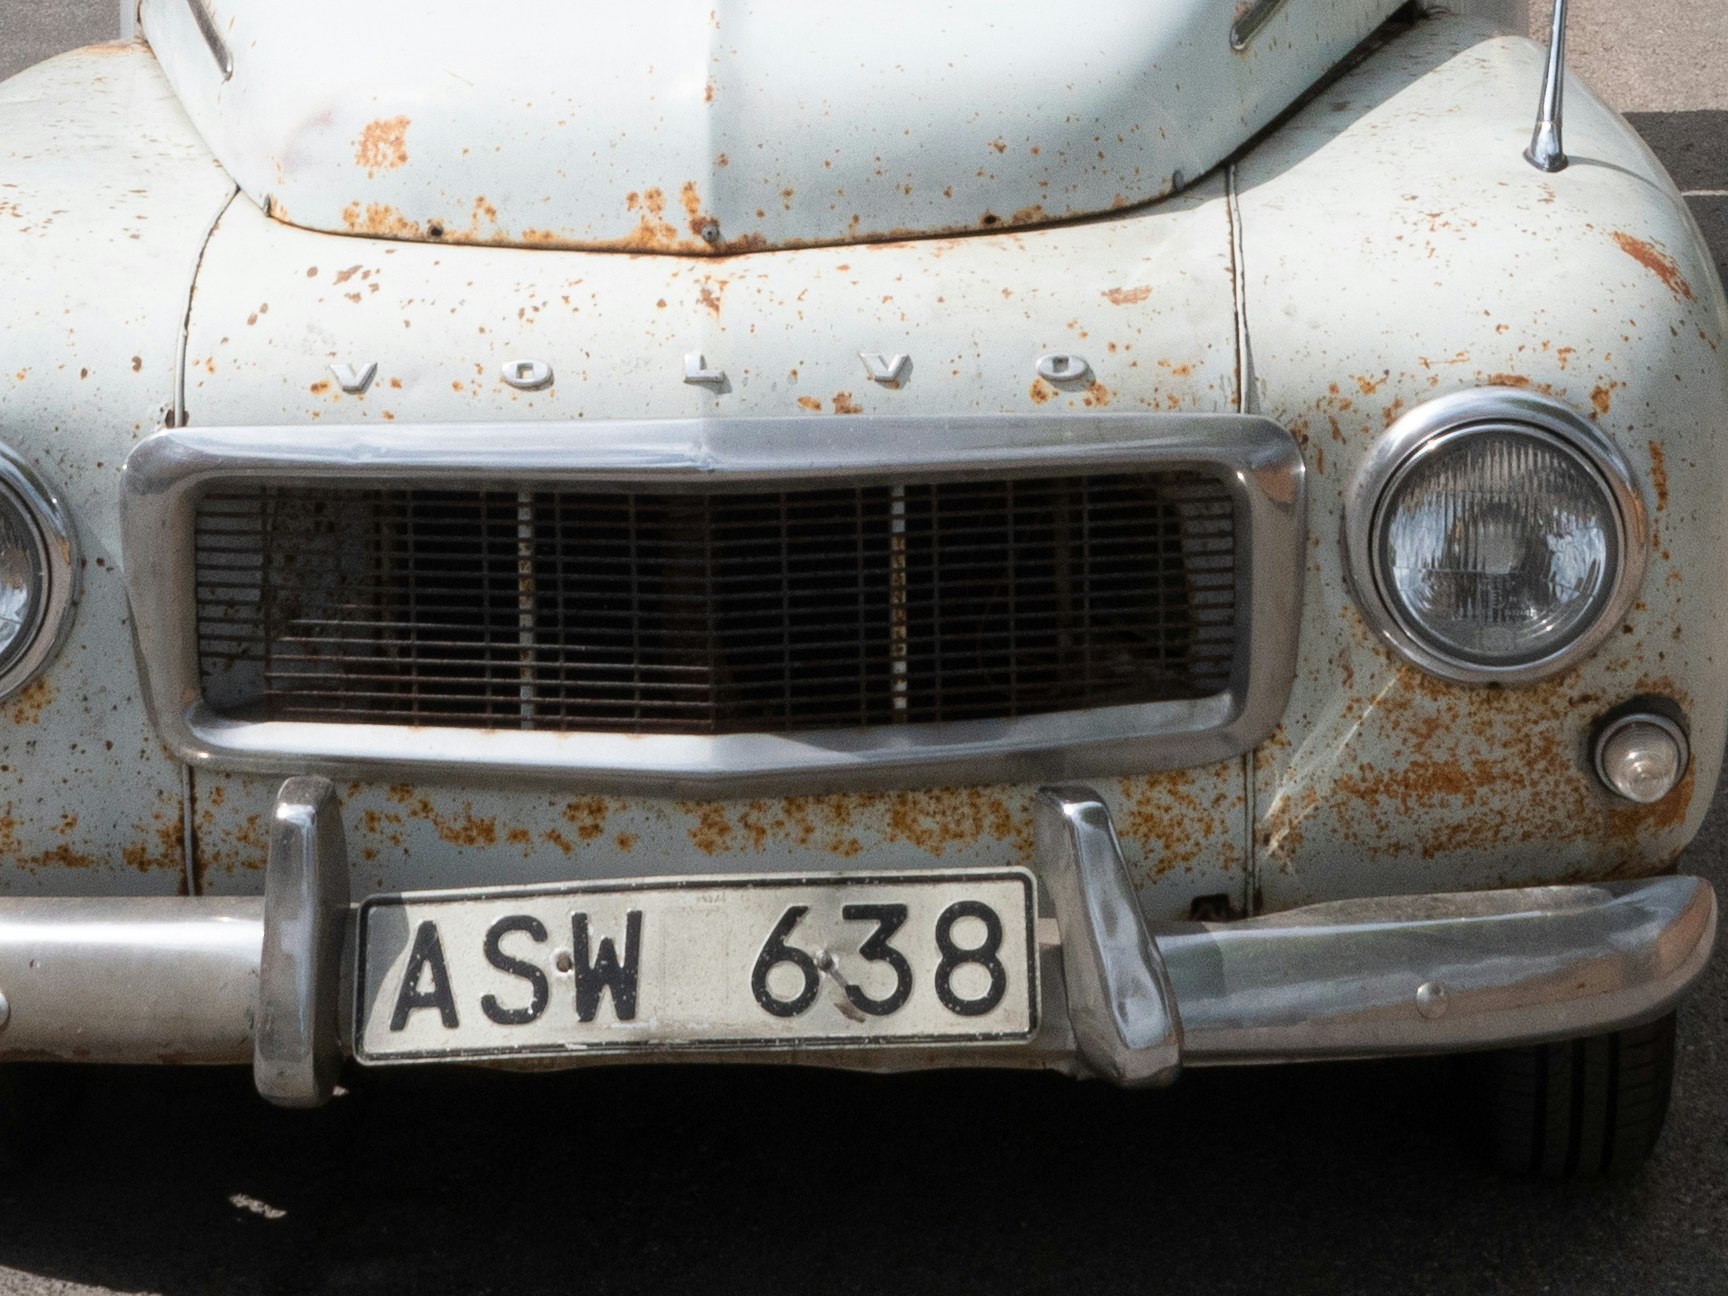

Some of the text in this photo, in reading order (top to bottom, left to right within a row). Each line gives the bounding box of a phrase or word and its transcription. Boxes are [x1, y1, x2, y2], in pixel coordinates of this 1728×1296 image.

[329, 351, 1090, 393] VOLVO
[389, 900, 1007, 1032] ASW 638
